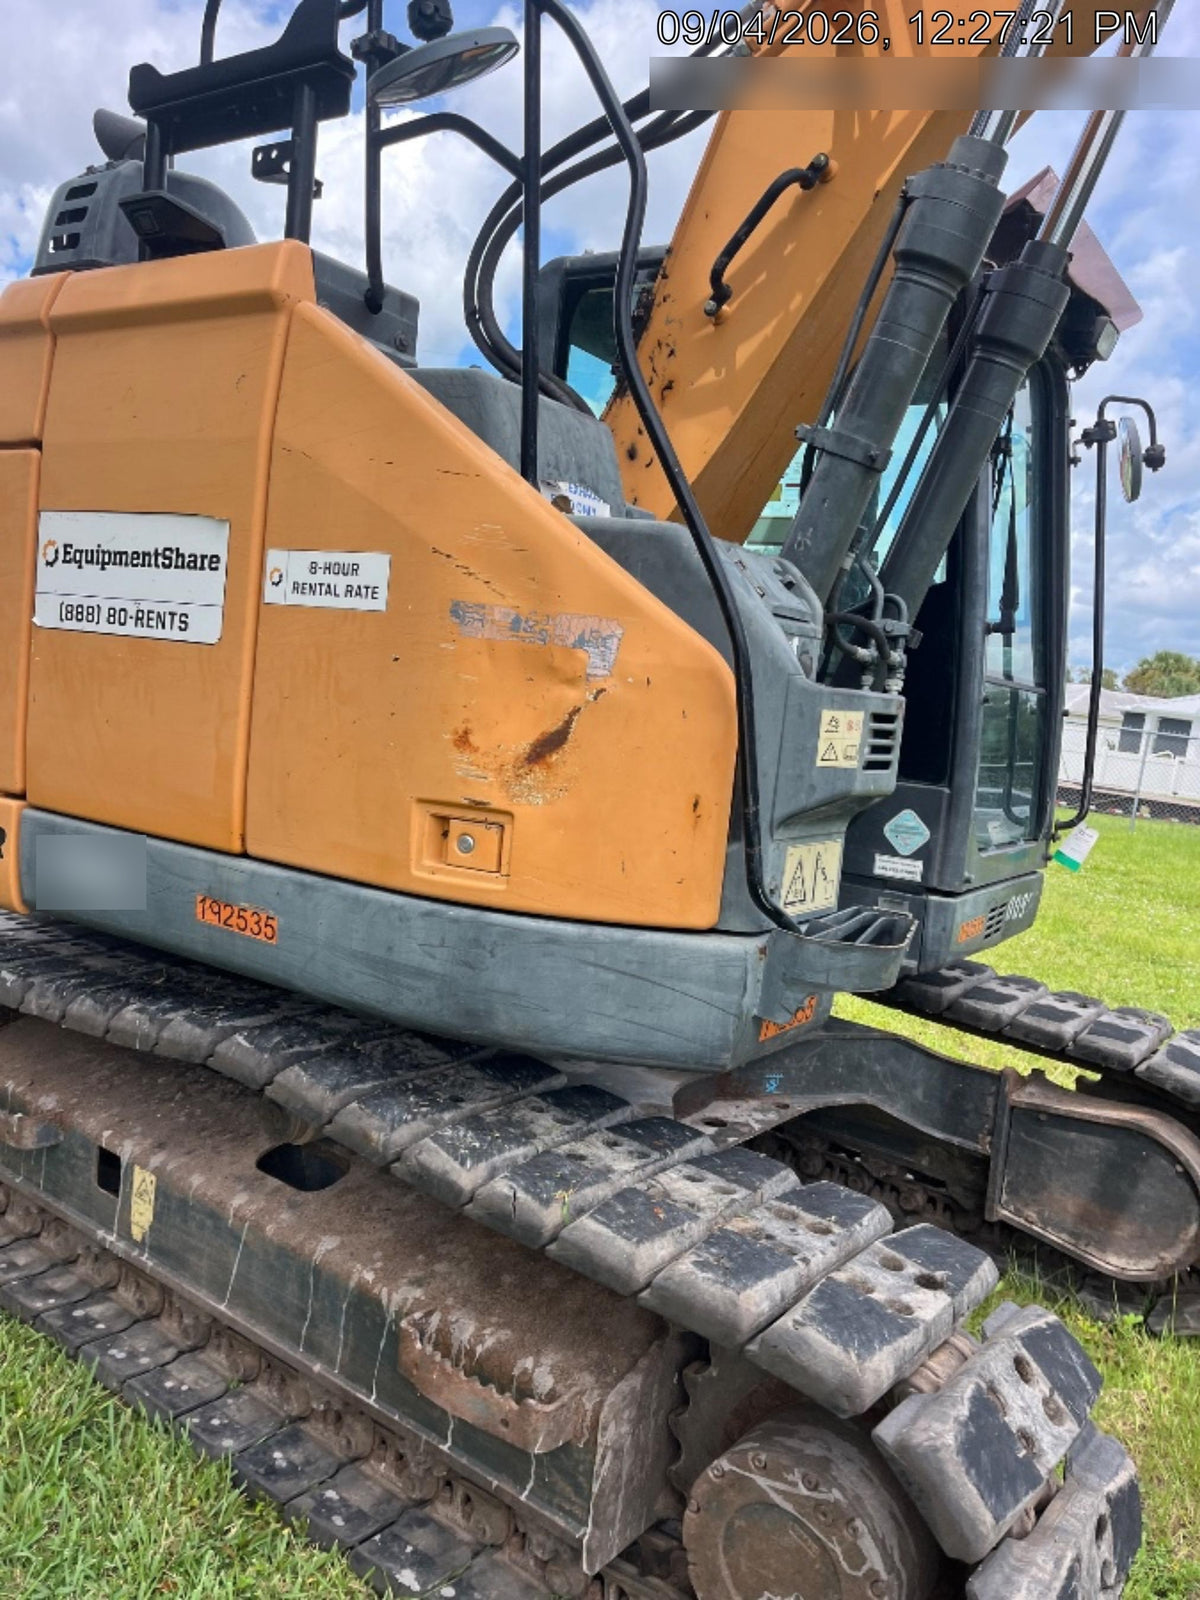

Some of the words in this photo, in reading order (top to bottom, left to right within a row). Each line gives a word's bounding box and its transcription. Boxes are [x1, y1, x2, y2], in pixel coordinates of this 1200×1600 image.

[61, 543, 221, 572] EquipmentShare
[309, 560, 361, 578] 8-HOUR
[291, 580, 341, 599] RENTAL
[344, 583, 380, 600] RATE
[59, 601, 100, 625] (888)
[106, 606, 190, 632] 80-RENTS
[198, 896, 277, 941] 192535
